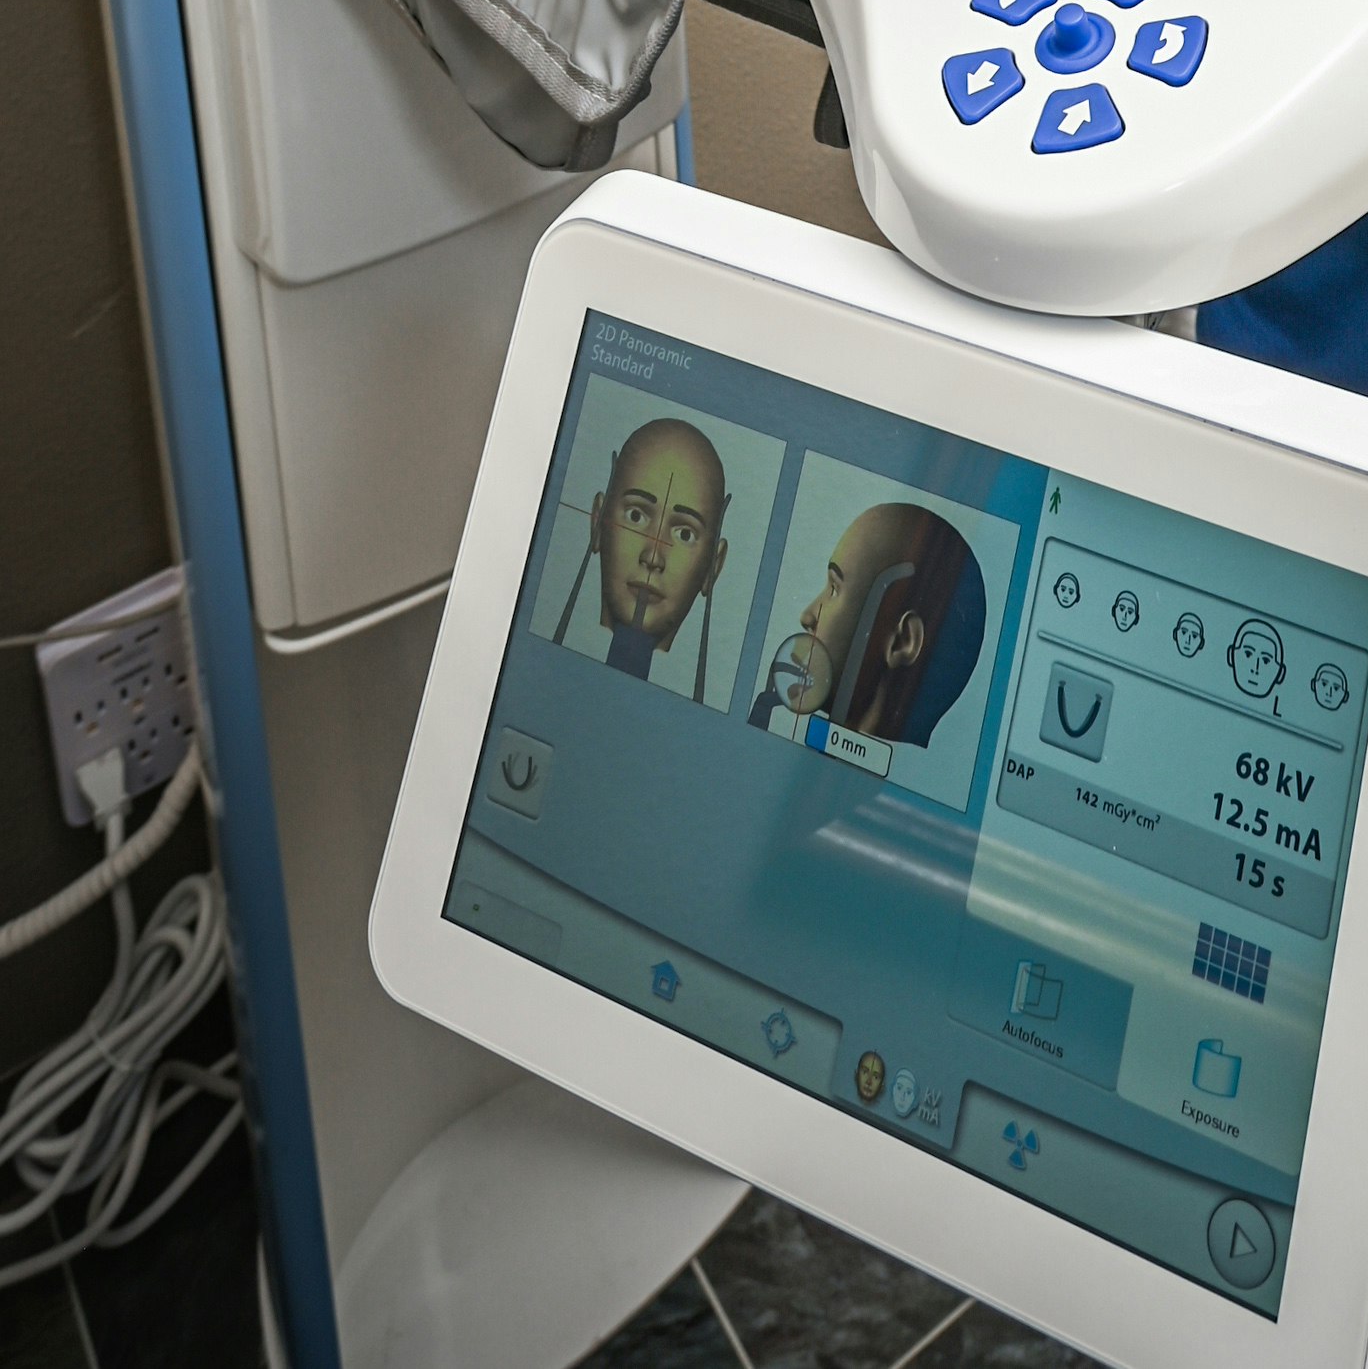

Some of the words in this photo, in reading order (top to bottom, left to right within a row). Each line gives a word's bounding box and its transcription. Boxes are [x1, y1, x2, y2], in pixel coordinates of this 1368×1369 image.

[591, 344, 654, 380] Standard
[596, 323, 616, 342] 2D
[619, 329, 692, 370] Panoramic
[831, 731, 839, 745] 0
[841, 738, 866, 758] mm
[1006, 759, 1035, 780] DAP
[1236, 752, 1270, 786] 68
[1276, 762, 1315, 803] kV
[1076, 787, 1099, 809] 142
[1213, 792, 1269, 837] 12.5
[1275, 822, 1321, 862] mA
[1235, 853, 1266, 889] 15
[1271, 875, 1285, 897] s
[1002, 1019, 1063, 1058] Autofocus
[918, 1106, 938, 1126] mA
[1181, 1099, 1240, 1138] Exposure
